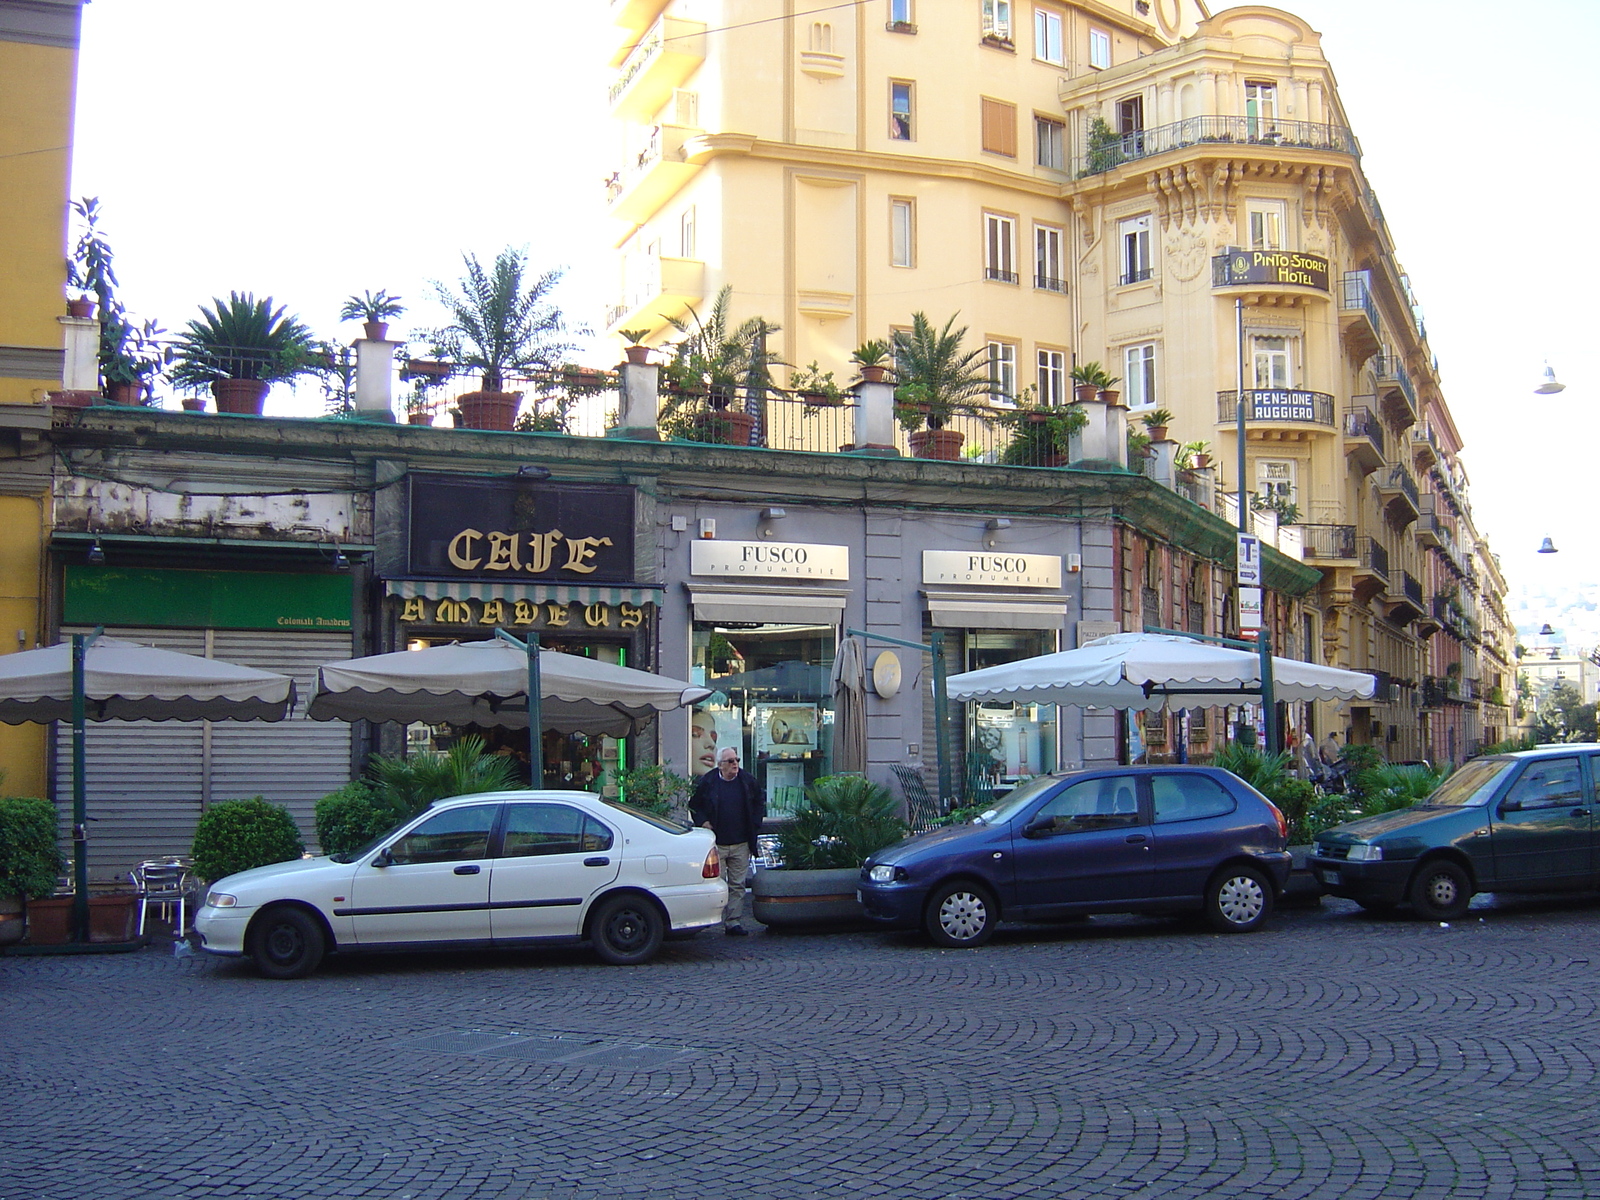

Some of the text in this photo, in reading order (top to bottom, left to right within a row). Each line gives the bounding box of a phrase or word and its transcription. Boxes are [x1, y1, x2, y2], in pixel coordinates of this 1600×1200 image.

[1278, 267, 1314, 286] HOTEL
[1254, 392, 1312, 406] PENSIONE
[1255, 406, 1313, 419] RUGGIERO
[741, 546, 808, 564] FUSCO
[710, 564, 834, 575] PROFUMERIE
[967, 556, 1027, 573] FUSCO
[940, 573, 1050, 584] PROFUMERIE
[400, 599, 643, 628] AMADEUS
